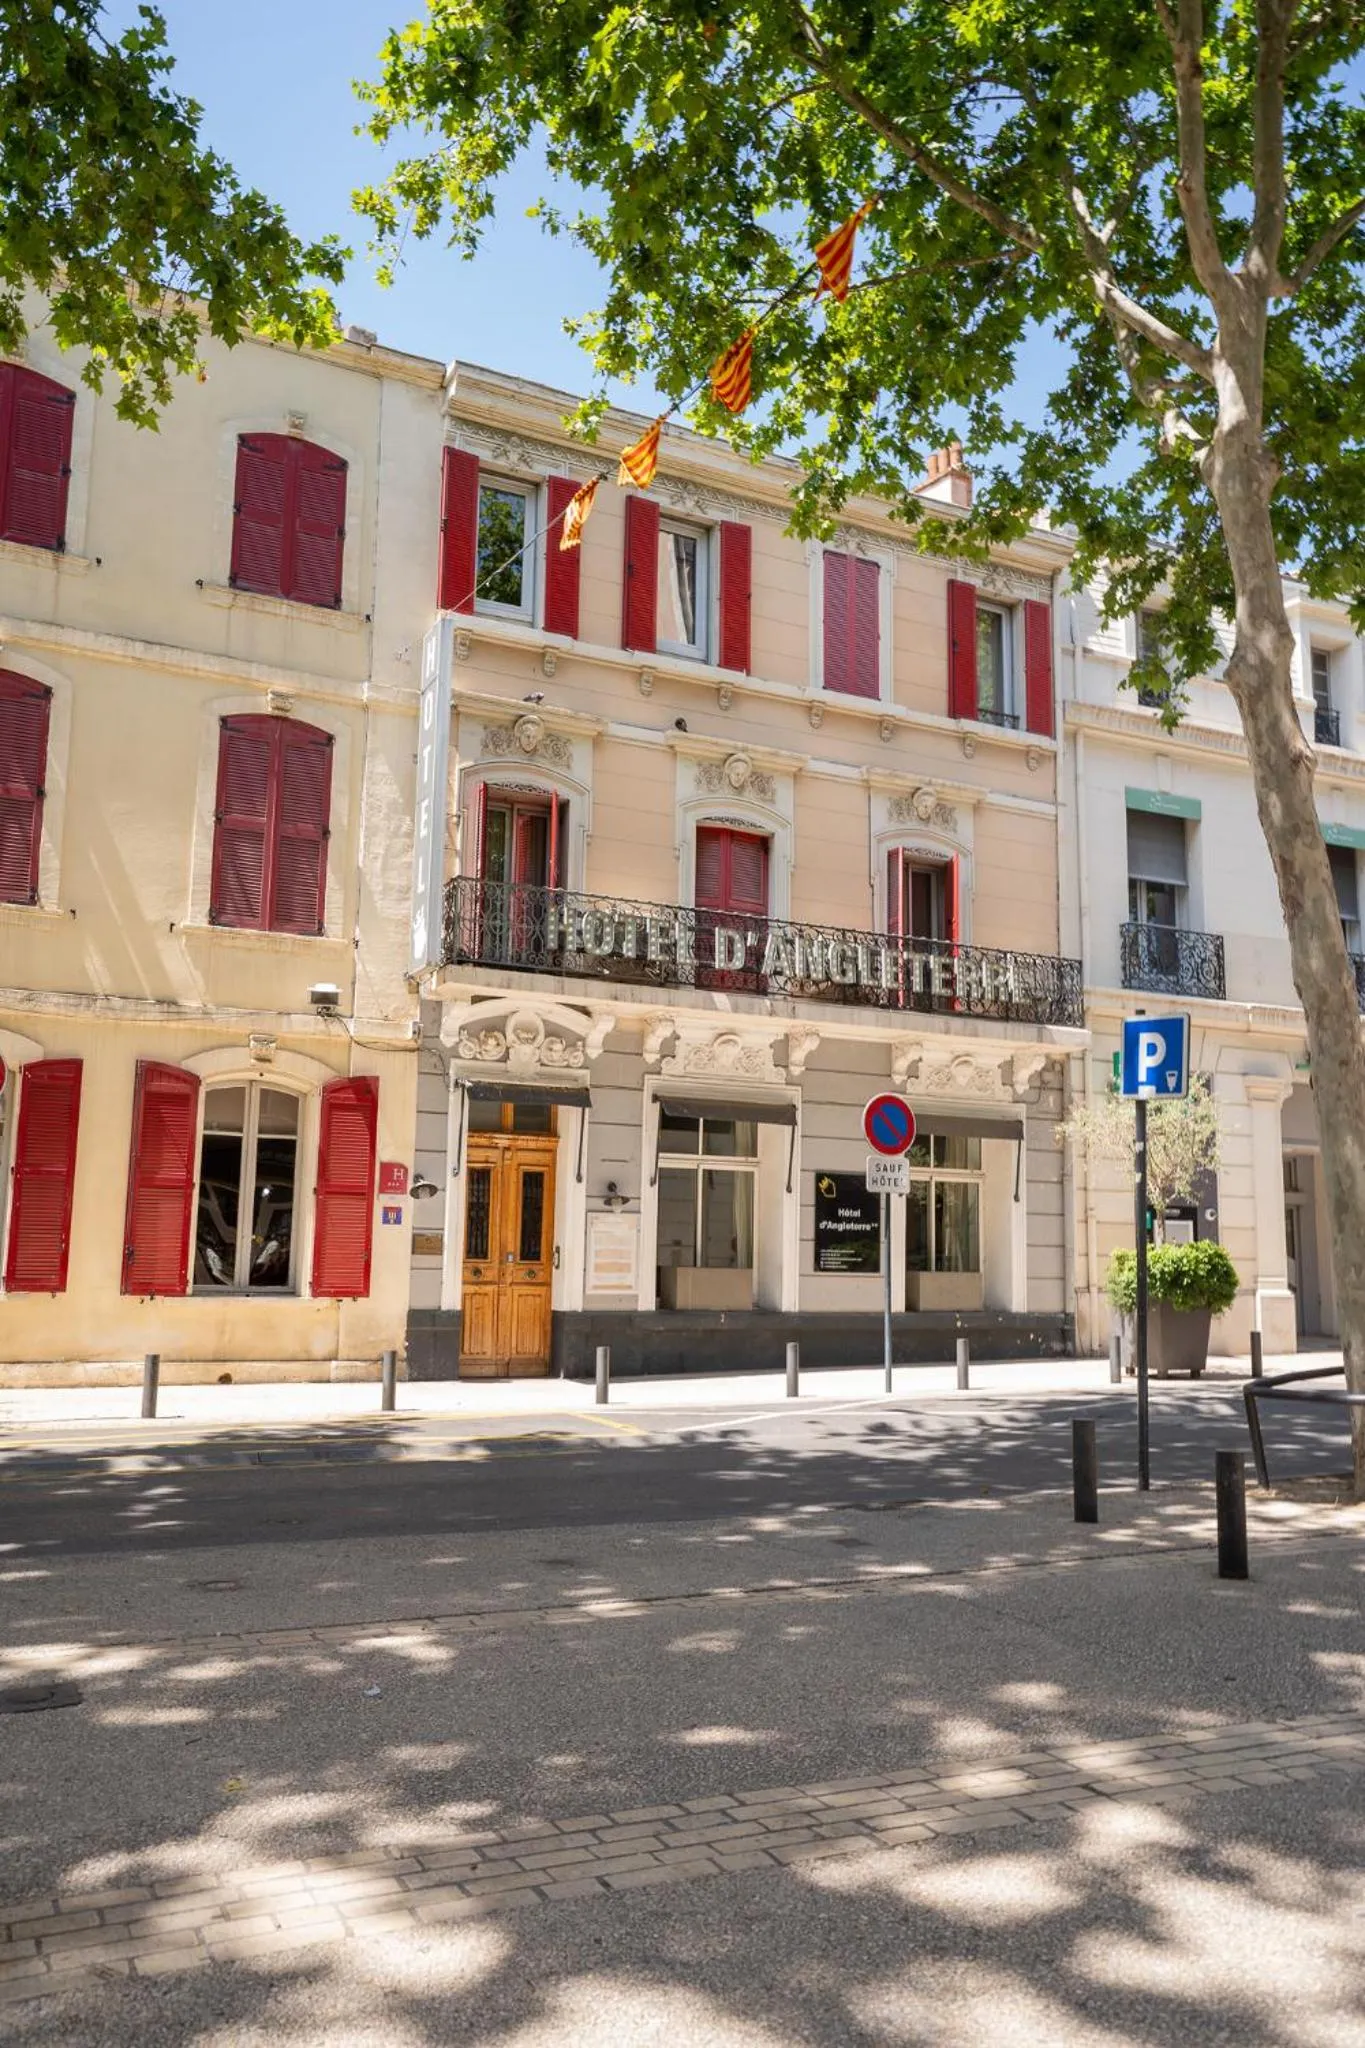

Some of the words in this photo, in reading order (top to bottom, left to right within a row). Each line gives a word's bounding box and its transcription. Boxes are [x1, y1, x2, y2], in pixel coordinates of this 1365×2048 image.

[416, 635, 437, 895] HOTEL
[547, 906, 698, 964] HOTEL
[714, 926, 1032, 1004] D'ANGLETERRE
[1138, 1031, 1167, 1083] P
[393, 1168, 404, 1180] H
[875, 1163, 904, 1173] SAUF
[837, 1208, 861, 1218] Hôtel
